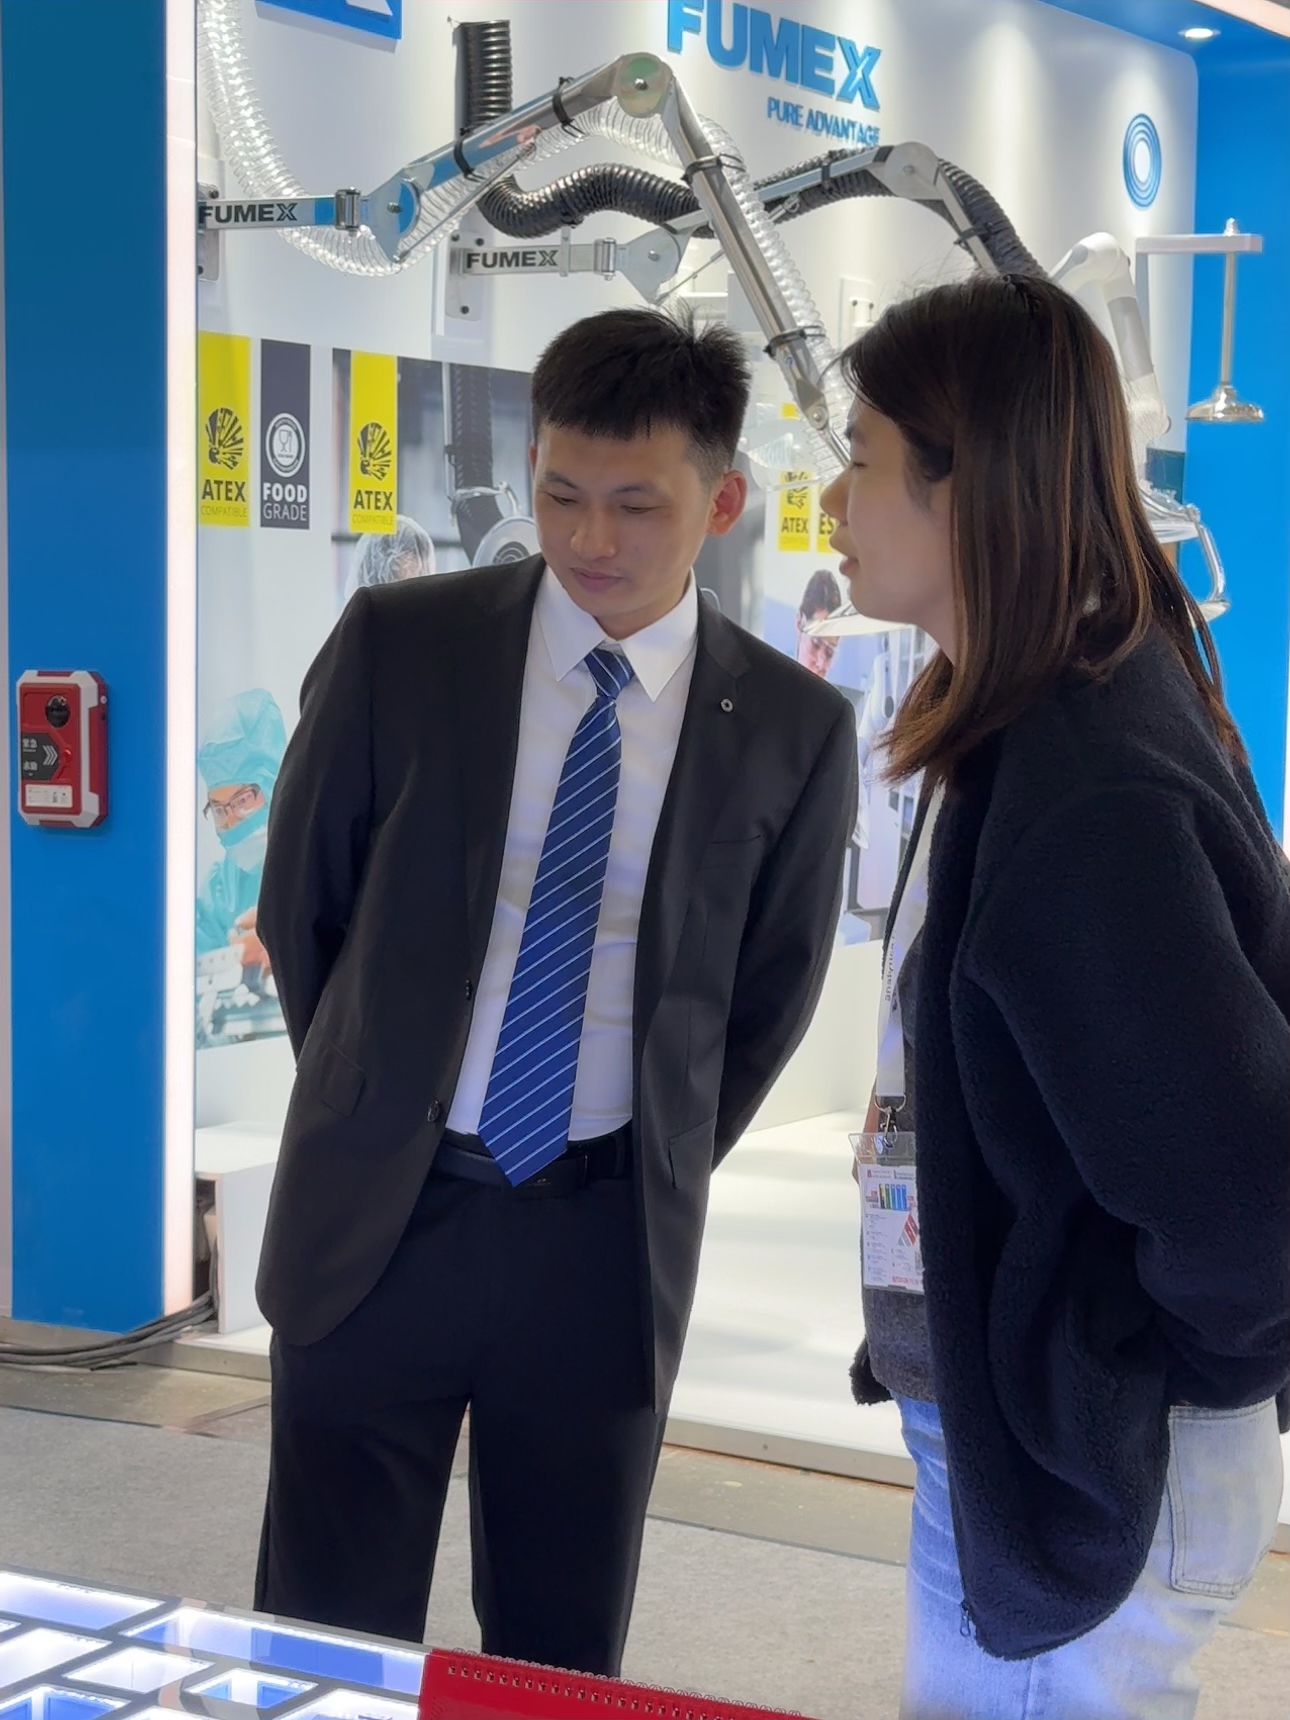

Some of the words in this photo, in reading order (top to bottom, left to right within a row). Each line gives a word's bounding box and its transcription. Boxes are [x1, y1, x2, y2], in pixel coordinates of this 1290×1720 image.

[667, 0, 882, 111] FUMEX
[767, 97, 804, 127] PURE
[805, 109, 881, 147] ADVANTAGE
[198, 202, 298, 224] FUMEX
[466, 250, 558, 269] FUMEX
[201, 479, 246, 502] ATEX
[263, 482, 308, 503] FOOD
[353, 489, 393, 511] ATEX
[200, 505, 247, 518] COMPATIBLE
[263, 503, 307, 521] GRADE
[781, 517, 809, 533] ATEX
